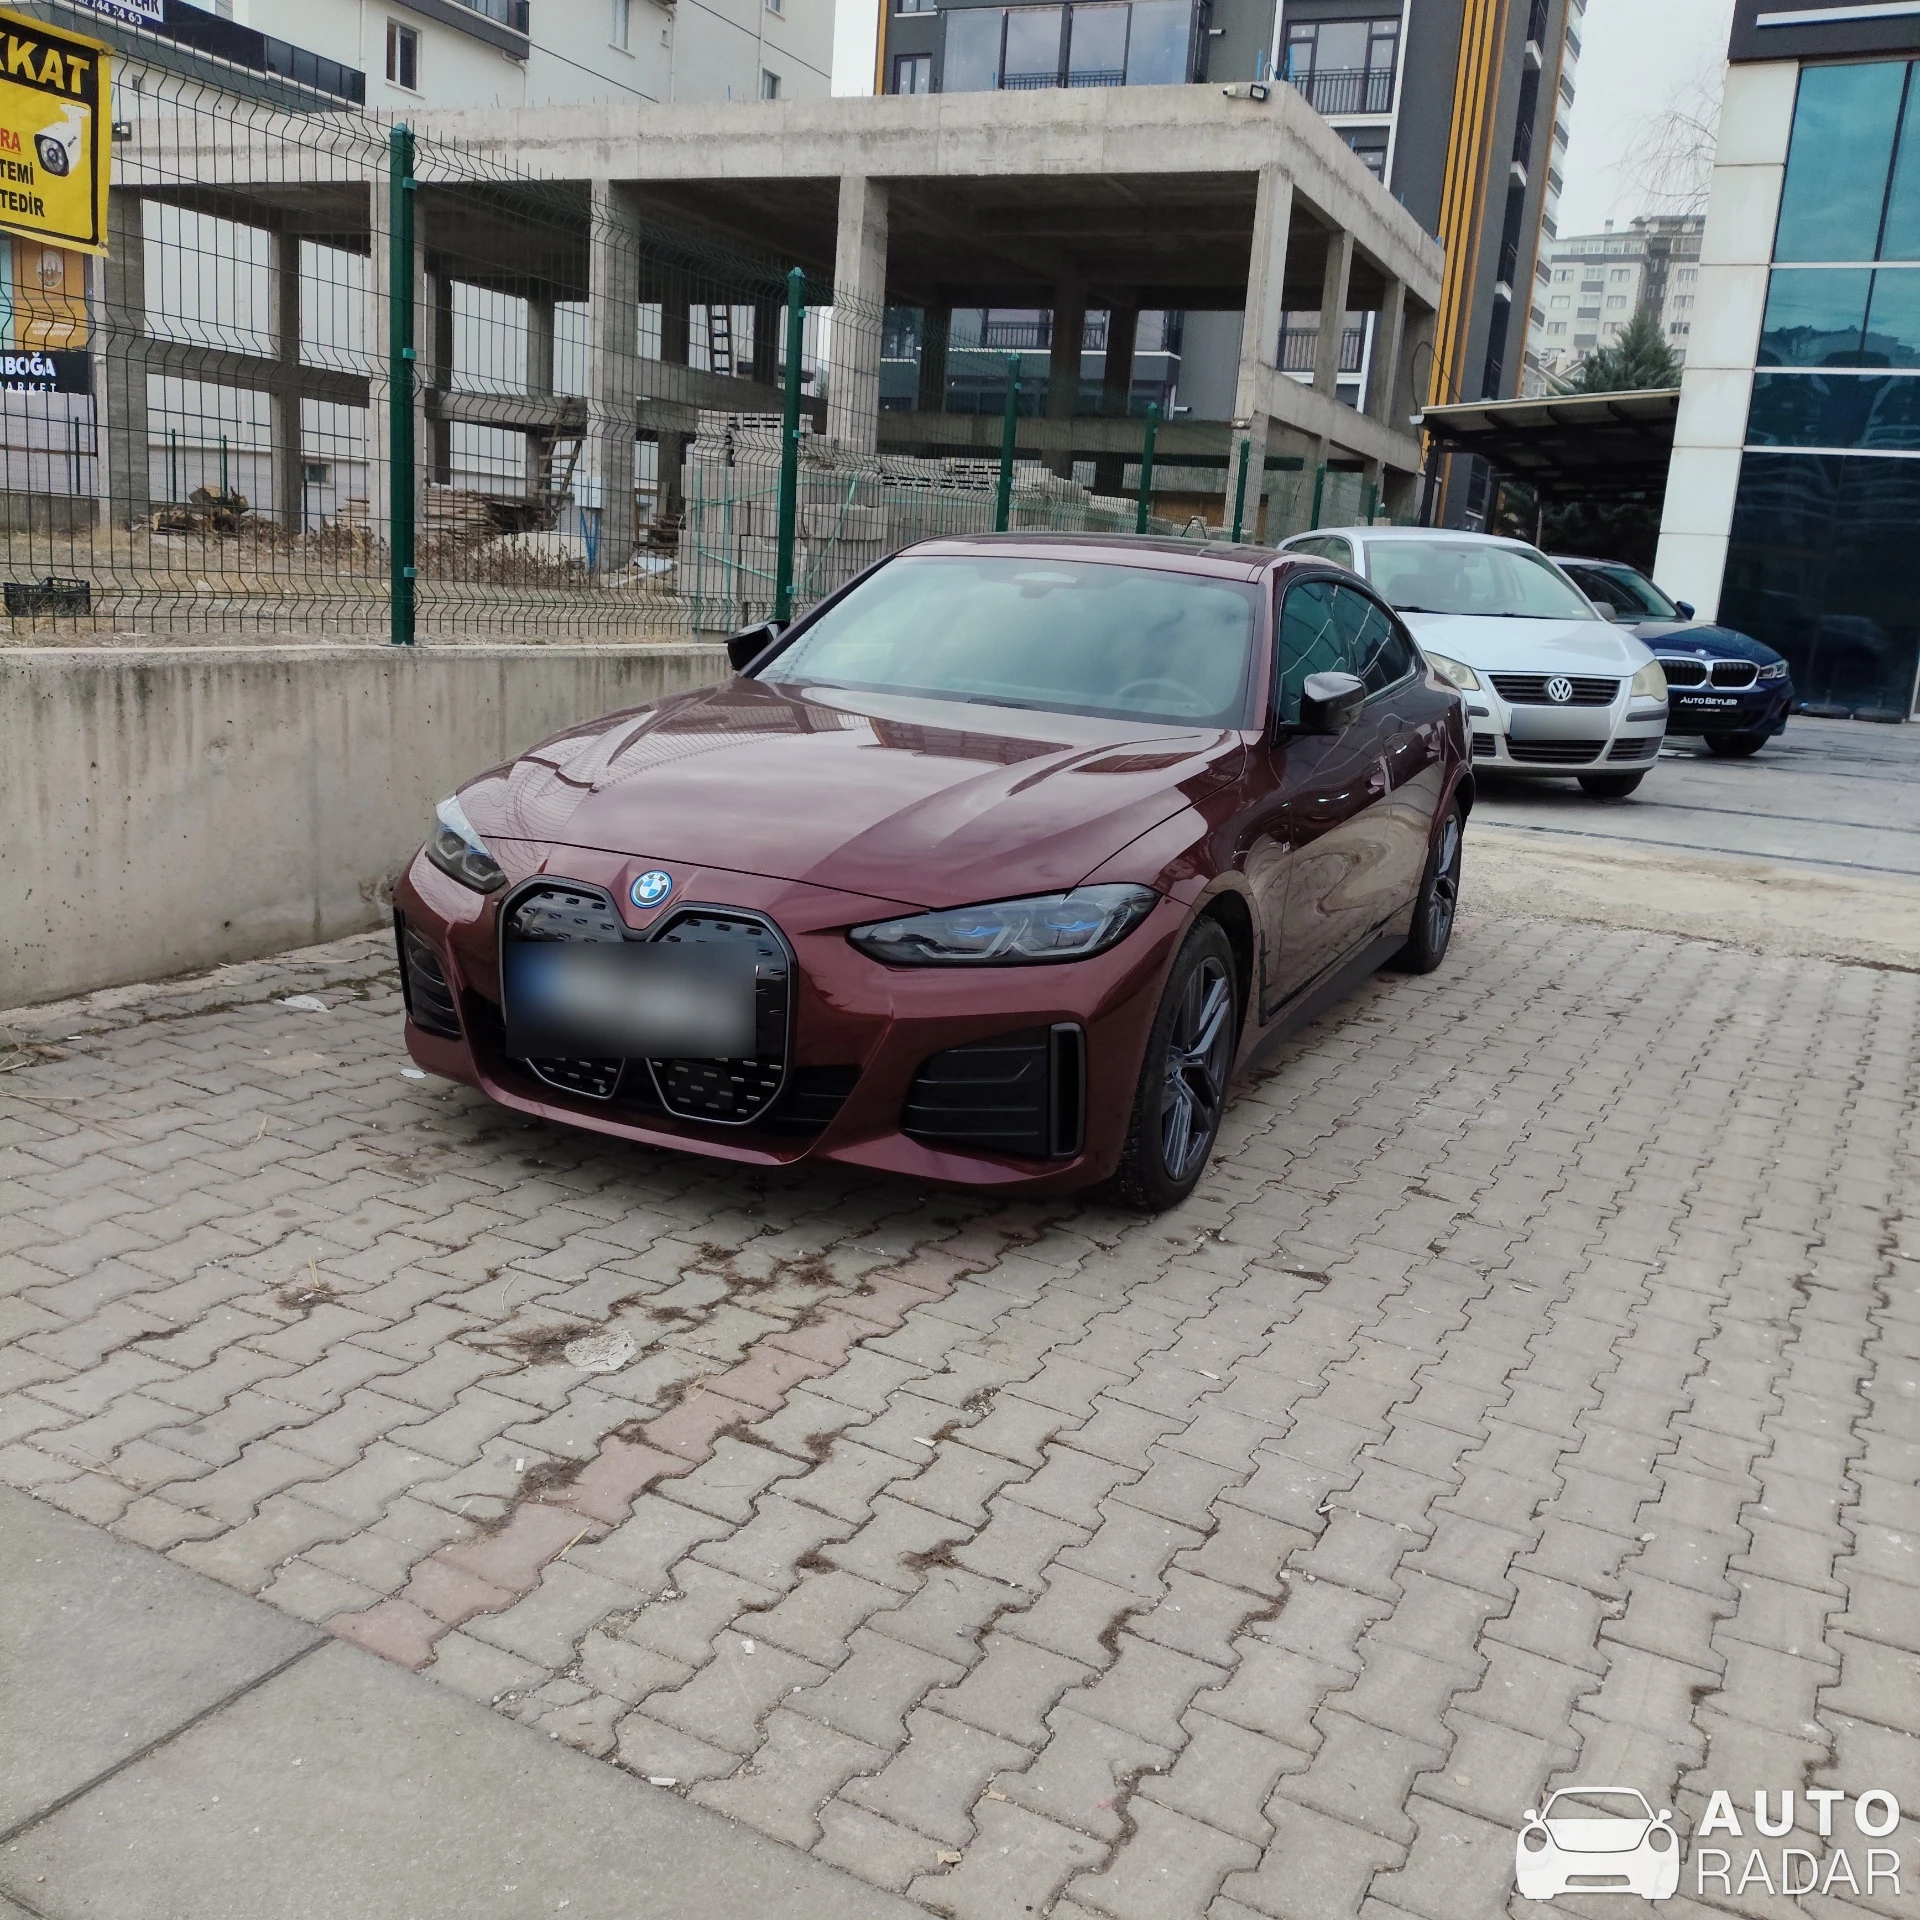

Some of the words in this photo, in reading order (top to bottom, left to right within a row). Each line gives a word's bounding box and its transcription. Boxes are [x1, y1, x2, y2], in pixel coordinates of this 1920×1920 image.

[128, 11, 143, 25] 60
[0, 31, 90, 95] KAT
[0, 381, 57, 393] ARKET
[1680, 696, 1705, 705] AUTO
[1704, 697, 1738, 706] BEYLER
